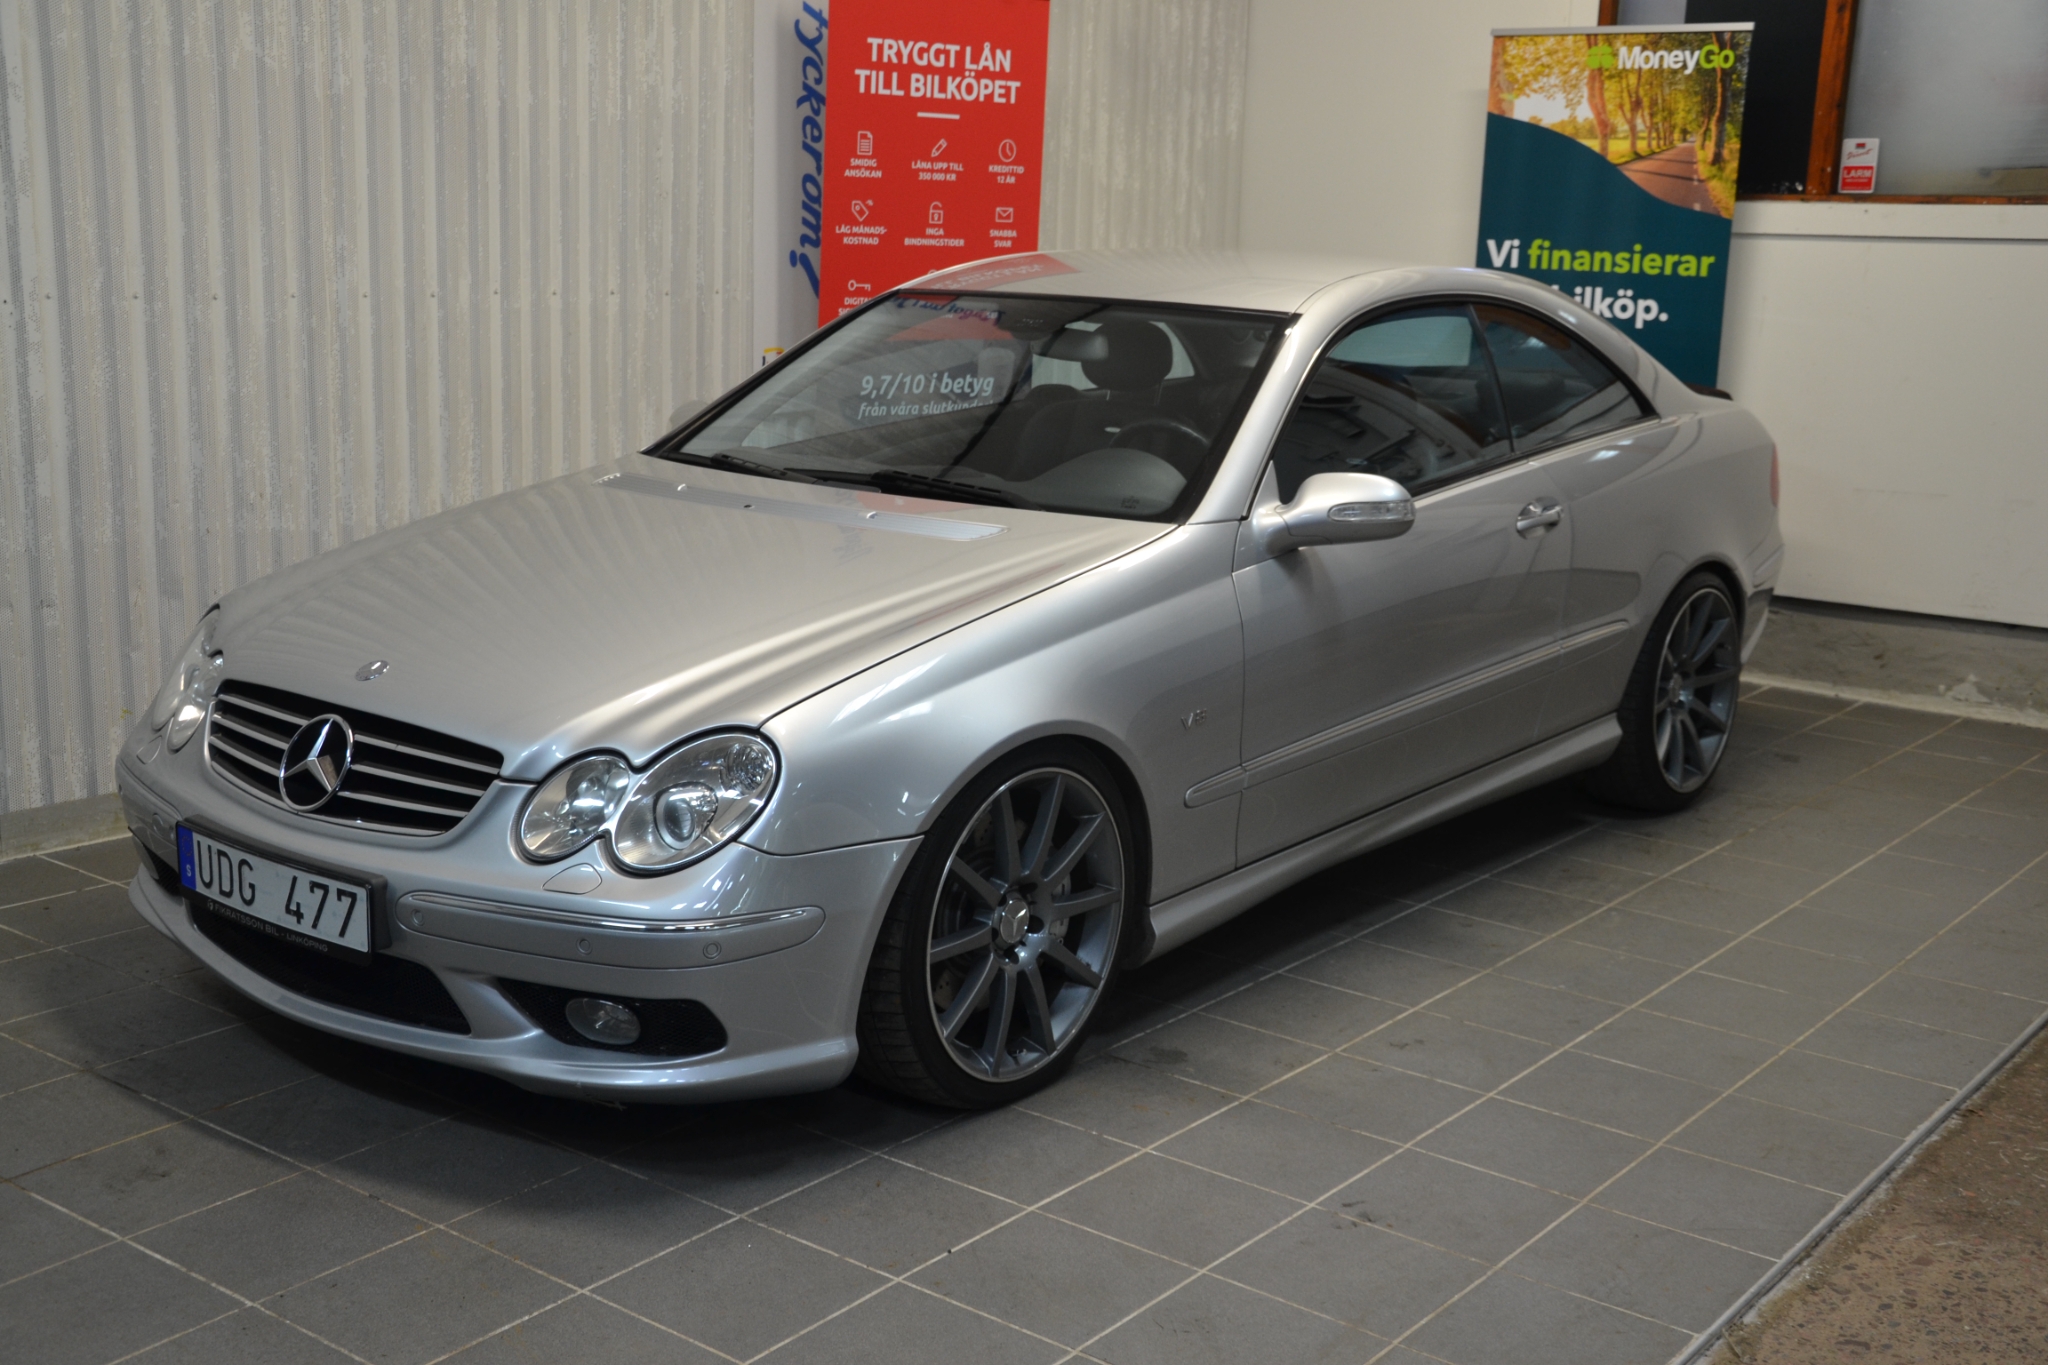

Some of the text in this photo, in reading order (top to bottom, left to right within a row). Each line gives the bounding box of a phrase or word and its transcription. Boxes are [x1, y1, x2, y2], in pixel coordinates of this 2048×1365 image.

[867, 37, 1012, 73] TRYGGT LÅN
[1617, 44, 1735, 75] MoneyGo
[855, 69, 1021, 104] TILL BILKÖPET
[850, 158, 877, 167] SMIDIG
[912, 160, 964, 171] LÅNA UPP TILL
[844, 168, 882, 178] ANSÖKAN
[988, 164, 1025, 174] KREDITTID
[1843, 169, 1873, 178] LARM
[918, 171, 932, 181] 350
[946, 173, 957, 181] KR
[1005, 174, 1016, 184] ÅR
[836, 224, 887, 235] LÅG MÅNADS-
[926, 227, 944, 236] INGA
[989, 229, 1017, 238] SNABBA
[843, 236, 879, 245] KOSTNAD
[904, 237, 965, 247] BINDNINGSTIDER
[994, 239, 1012, 248] SVAR
[1487, 239, 1715, 278] Vi finansierar
[1551, 285, 1669, 329] ilköp.
[860, 372, 995, 400] 9,7/10 i betyg
[858, 402, 887, 420] från
[890, 402, 919, 415] våra
[186, 864, 192, 877] S
[197, 840, 358, 938] UDG 477
[215, 904, 264, 931] FIKRATSSON
[265, 925, 279, 937] BIL
[286, 931, 329, 953] LINKÖPING
